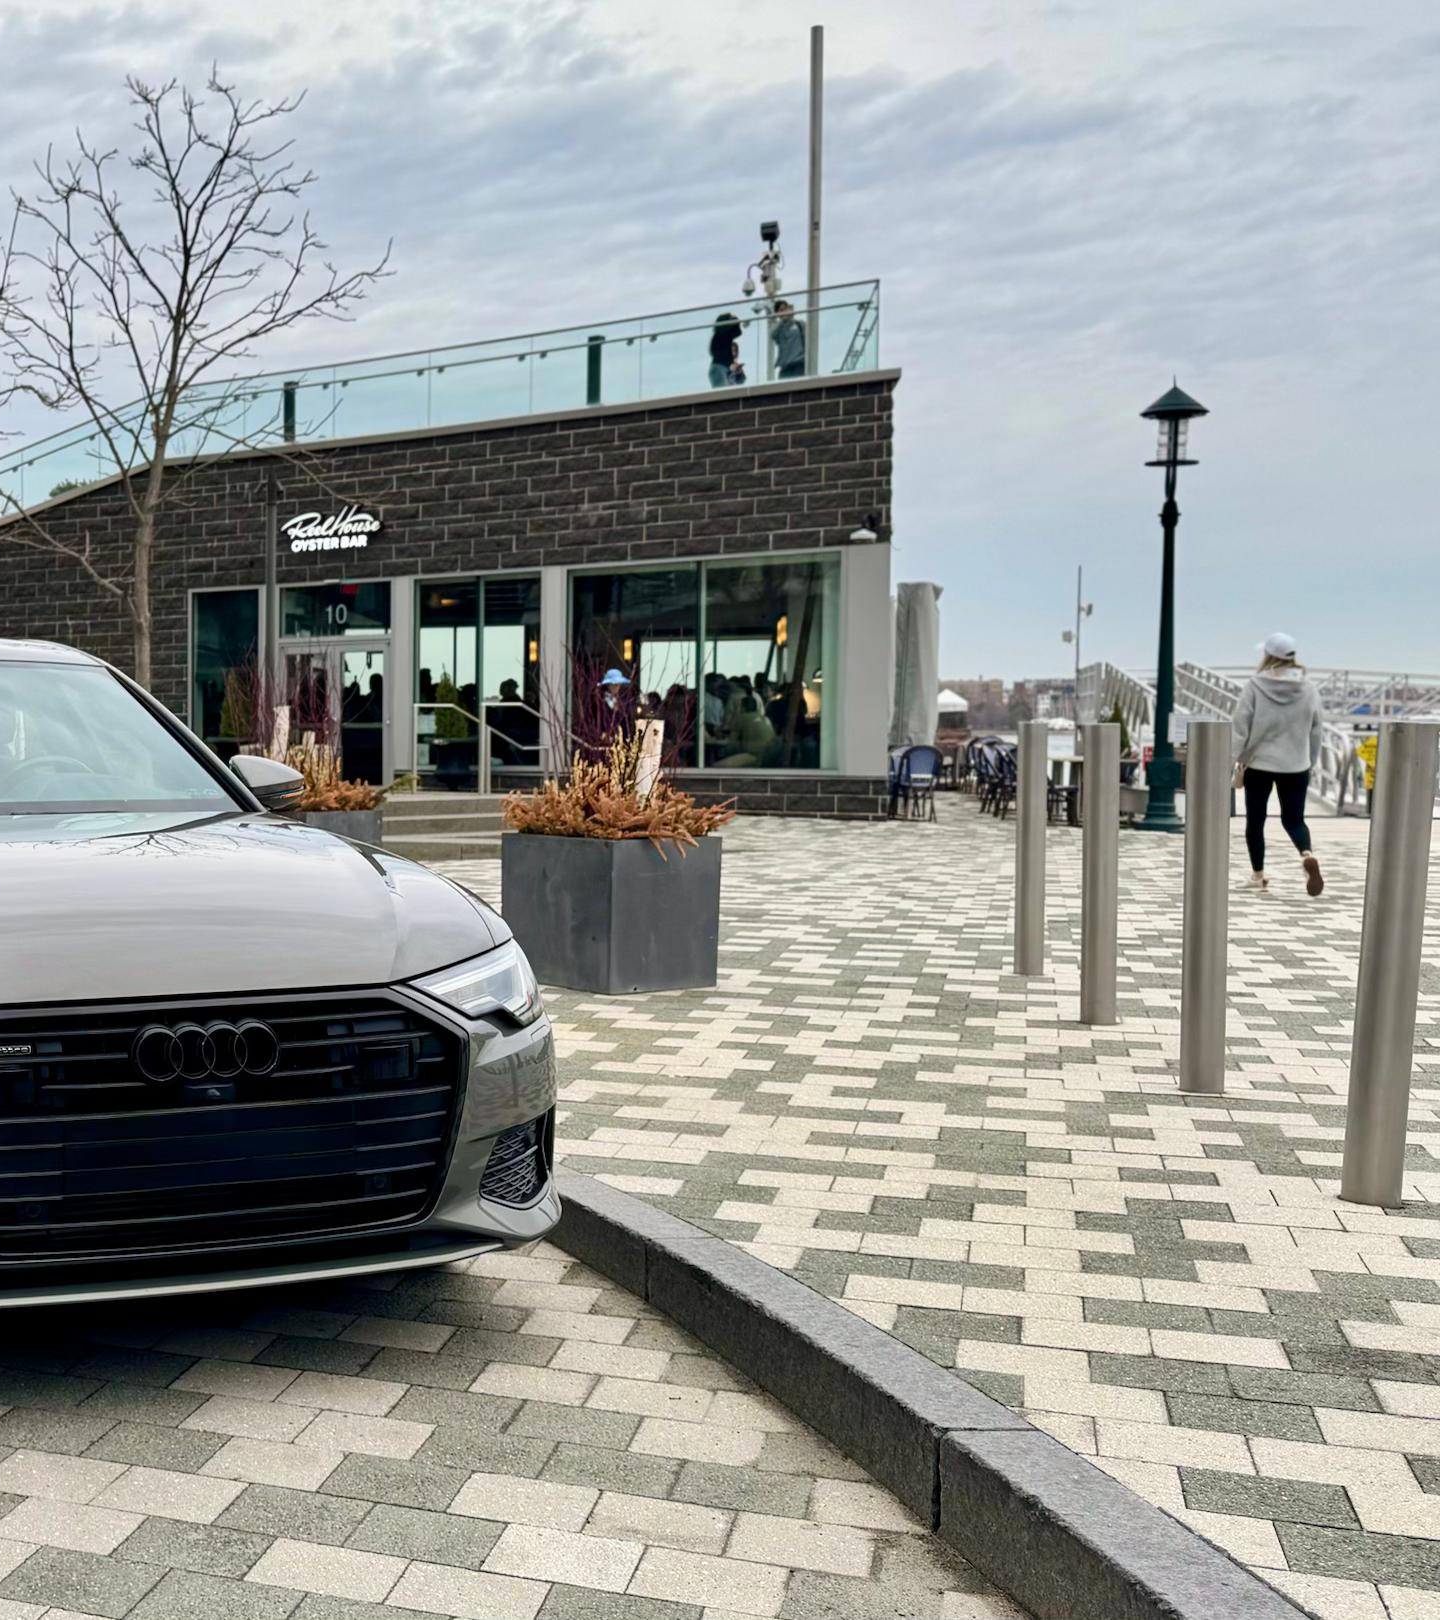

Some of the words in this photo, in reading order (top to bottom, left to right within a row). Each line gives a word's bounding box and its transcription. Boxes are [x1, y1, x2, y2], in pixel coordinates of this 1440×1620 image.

[291, 537, 340, 552] OYSTER
[340, 535, 368, 549] BAR
[326, 604, 347, 624] 10
